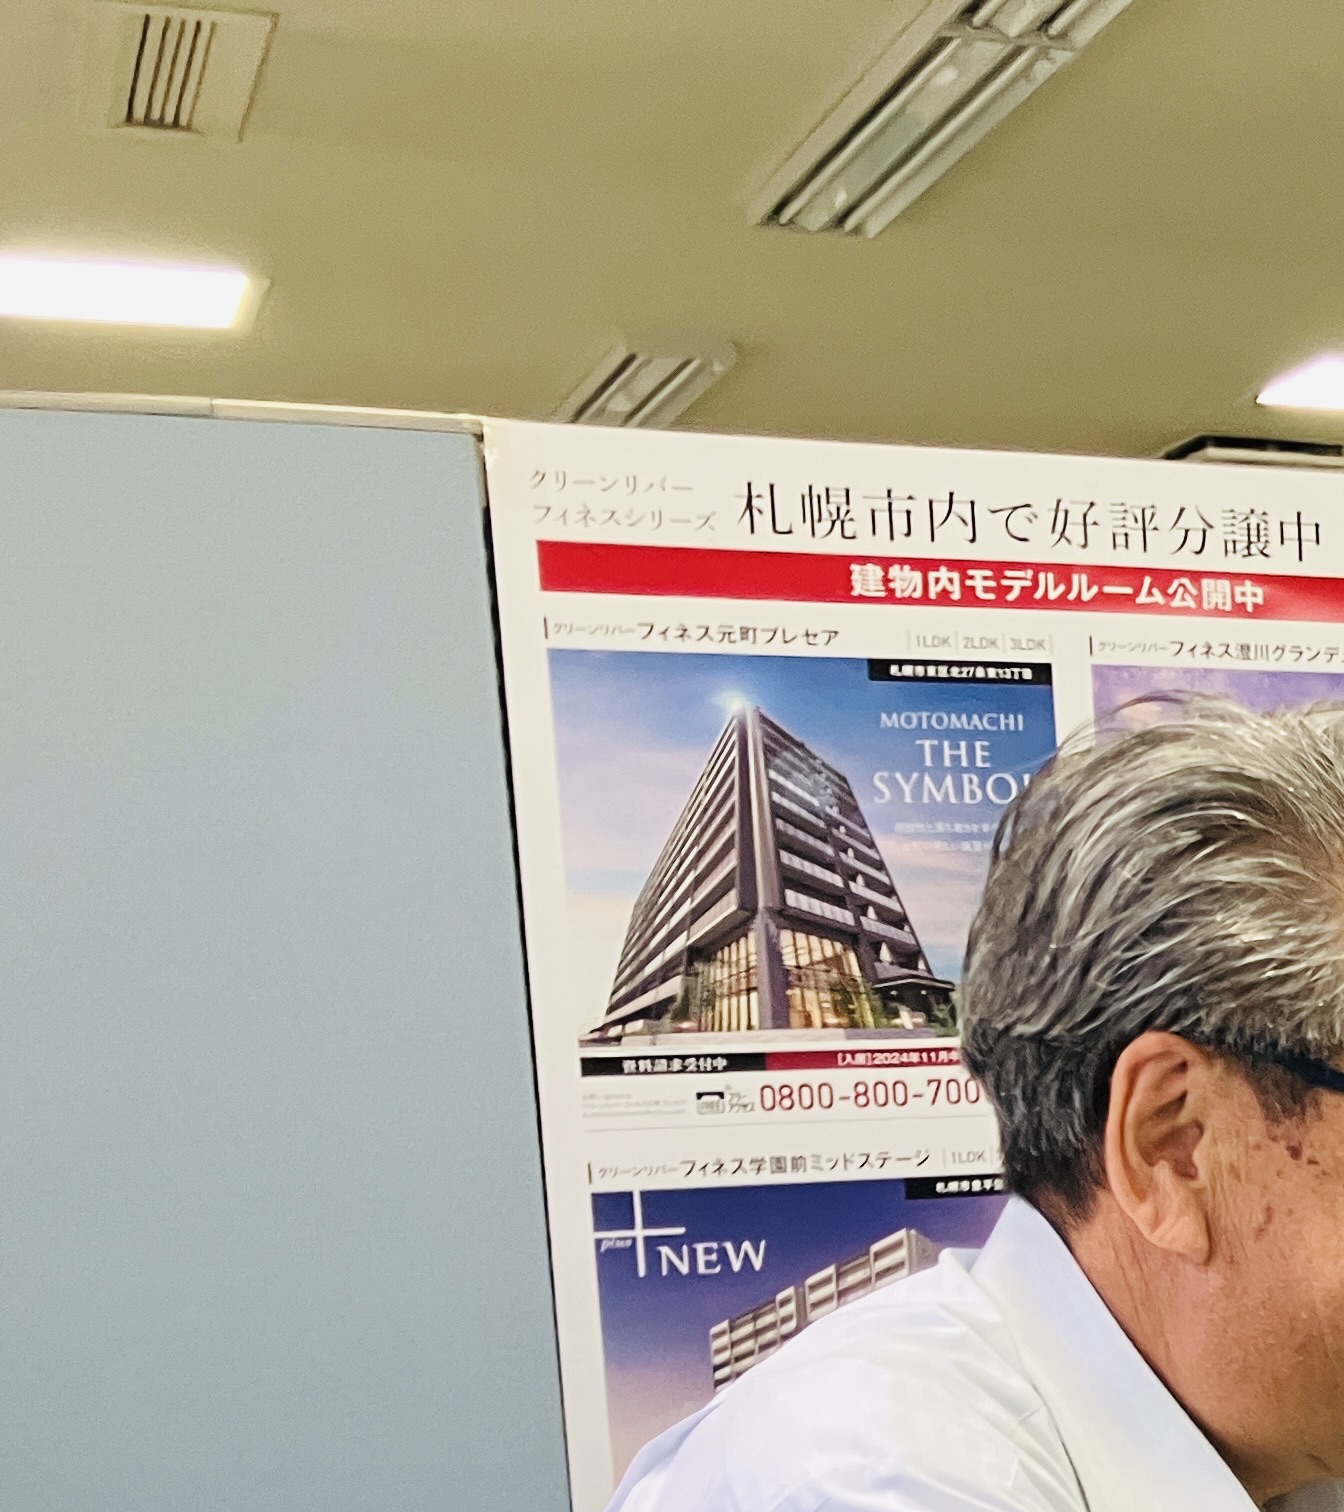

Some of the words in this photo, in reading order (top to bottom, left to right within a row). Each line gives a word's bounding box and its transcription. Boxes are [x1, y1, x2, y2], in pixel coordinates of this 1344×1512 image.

[533, 504, 717, 532] フィネスシリーズ
[735, 481, 1321, 562] 札幌市内で好評分譲中
[850, 562, 1264, 613] 建物内モデルルーム公開中
[880, 711, 1025, 731] MOTOMACHI
[915, 739, 991, 768] THE
[656, 1239, 766, 1277] NEW
